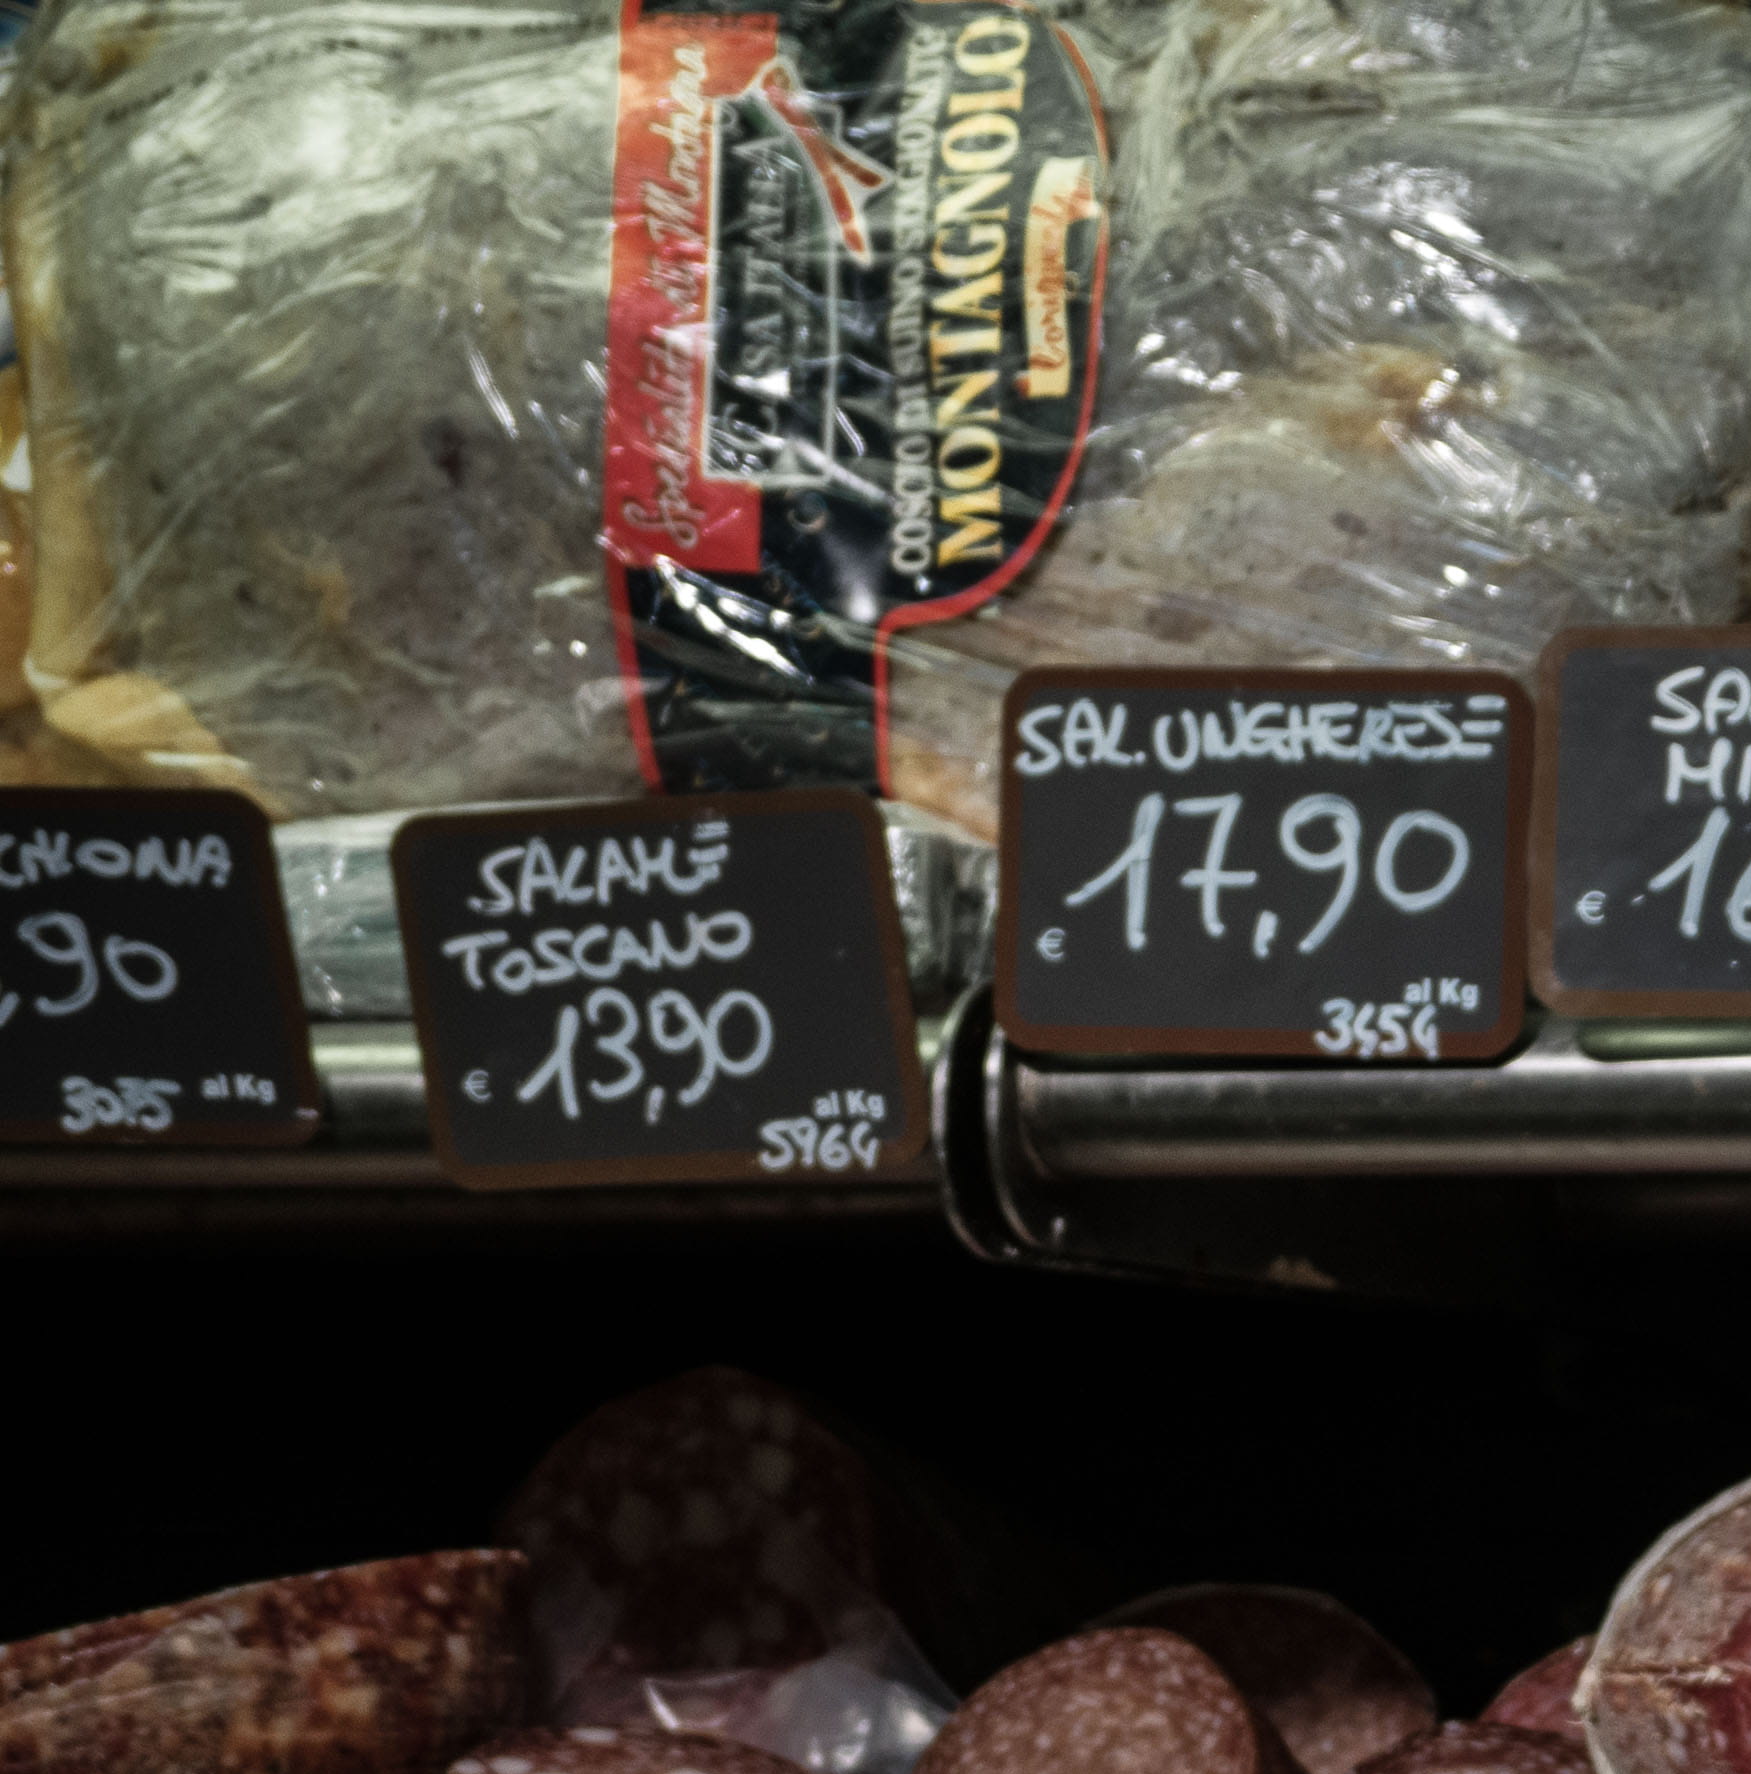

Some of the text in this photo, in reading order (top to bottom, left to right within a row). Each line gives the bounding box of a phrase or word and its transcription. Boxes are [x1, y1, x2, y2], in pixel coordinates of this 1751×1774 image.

[889, 254, 927, 376] SUINO
[931, 15, 1030, 568] MONTAGNOLO
[892, 383, 931, 431] DI
[891, 434, 933, 573] COSCIO
[1014, 698, 1146, 776] SAL.
[468, 819, 731, 918] SALAME
[1035, 792, 1470, 962] € 17,90
[1576, 890, 1607, 924] €
[442, 910, 753, 993] TOSCANO
[1403, 978, 1480, 1013] al Kg
[202, 1073, 230, 1100] al
[234, 1073, 278, 1106] Kg
[462, 988, 774, 1127] € 13,90
[813, 1090, 887, 1124] al Kg
